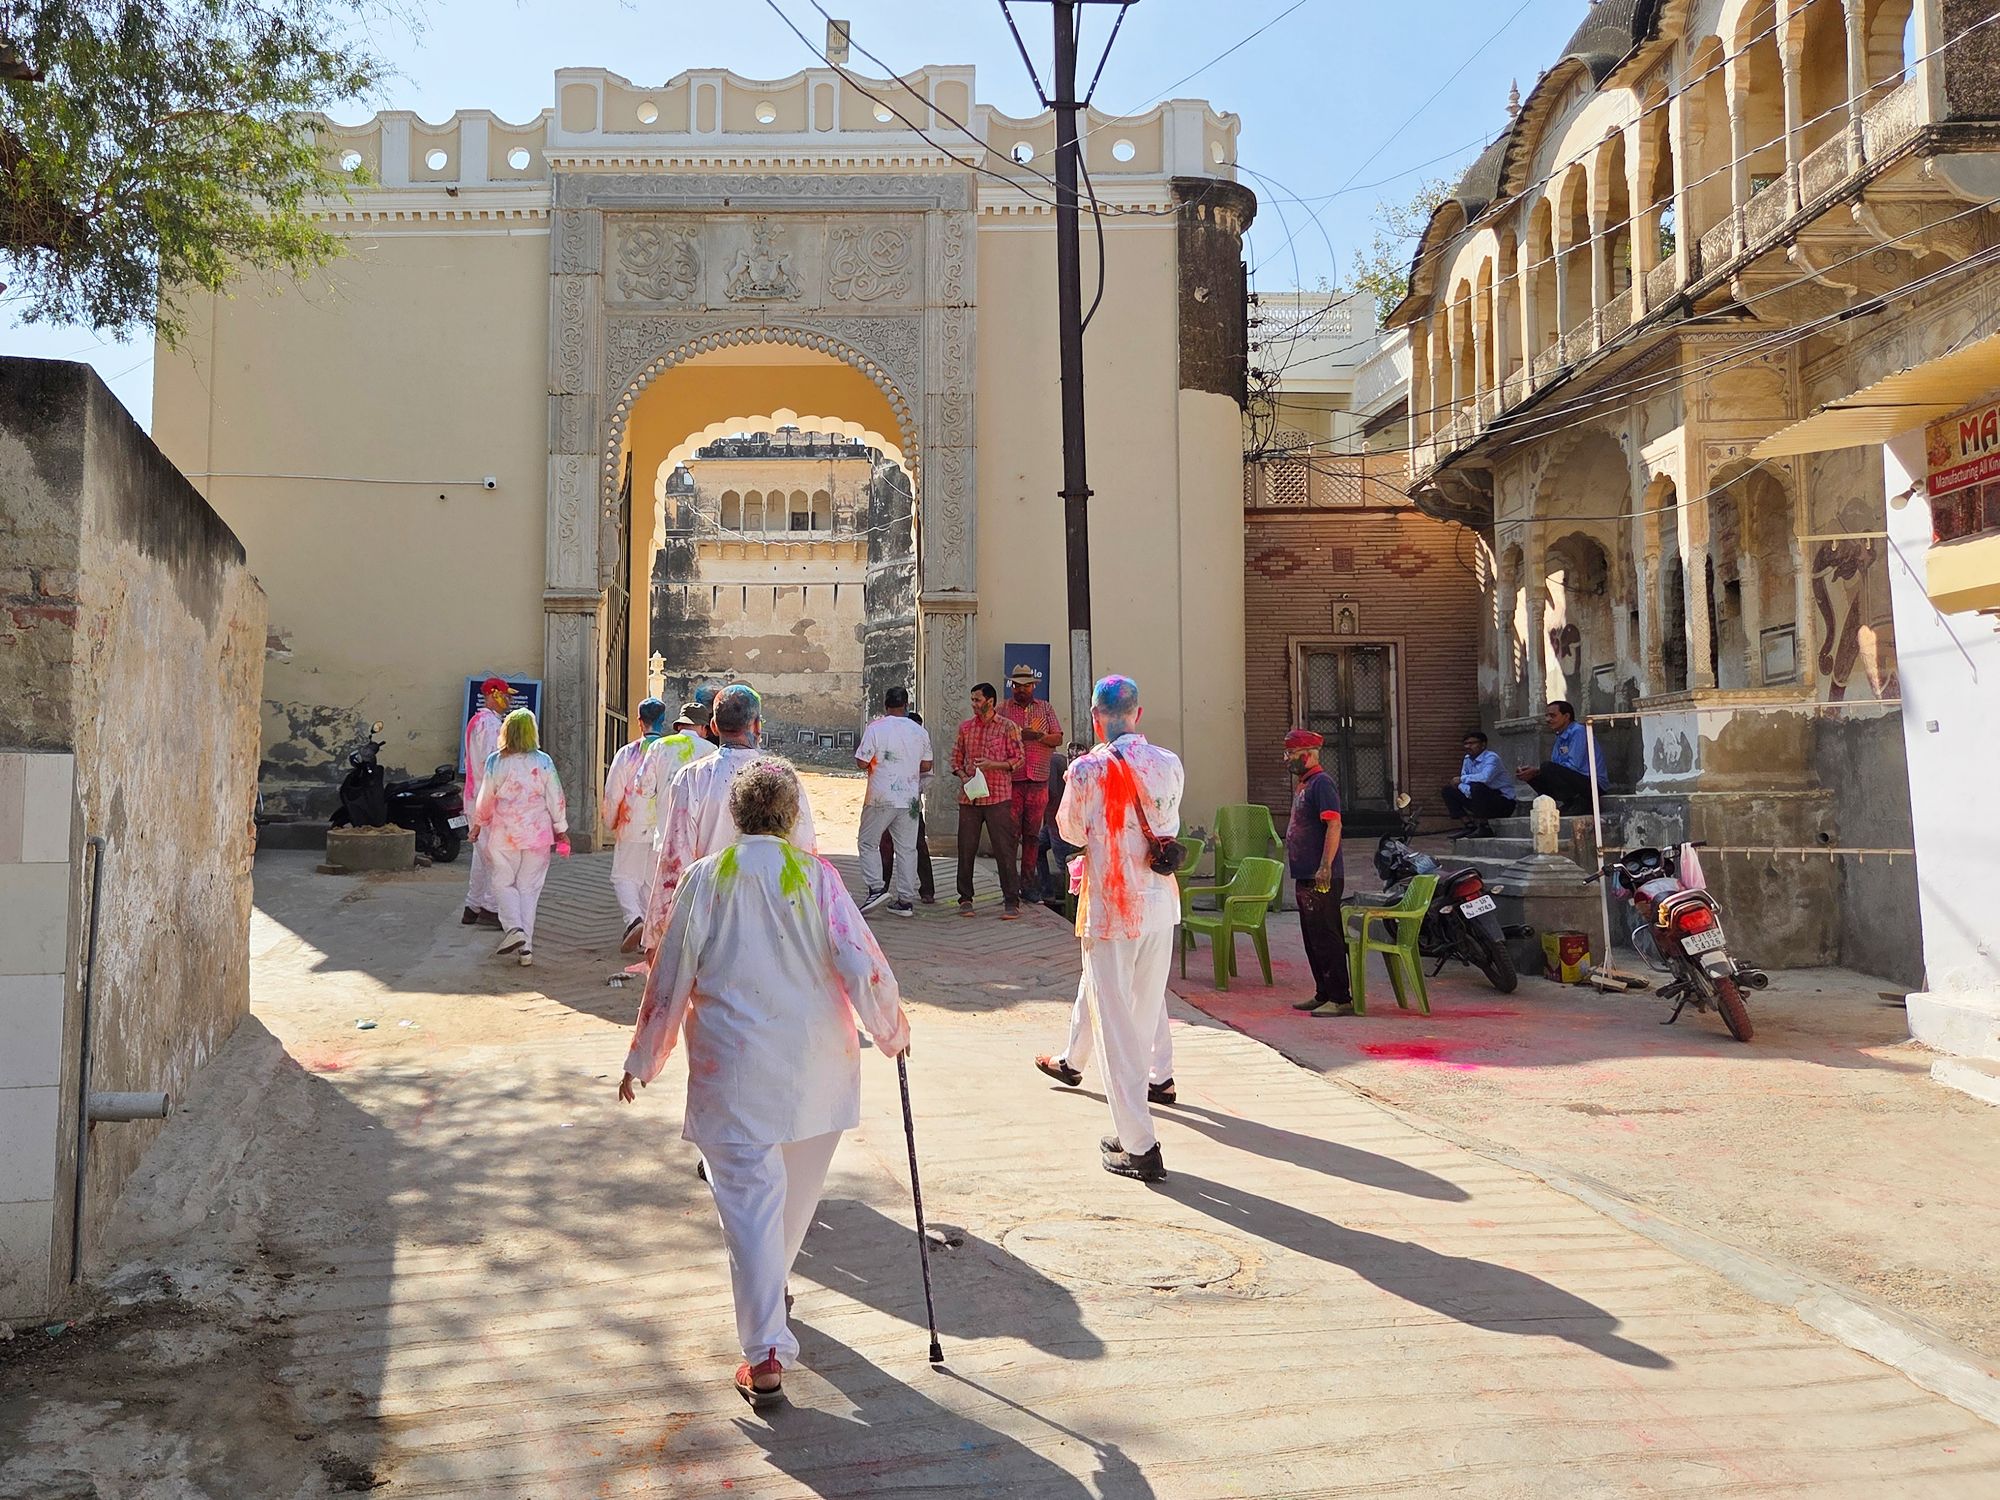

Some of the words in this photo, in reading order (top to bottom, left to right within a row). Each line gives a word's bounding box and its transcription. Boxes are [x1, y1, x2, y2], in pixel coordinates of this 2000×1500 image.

[1958, 407, 2000, 457] MA
[1935, 465, 1979, 489] Manufacturing
[1979, 458, 1988, 475] All
